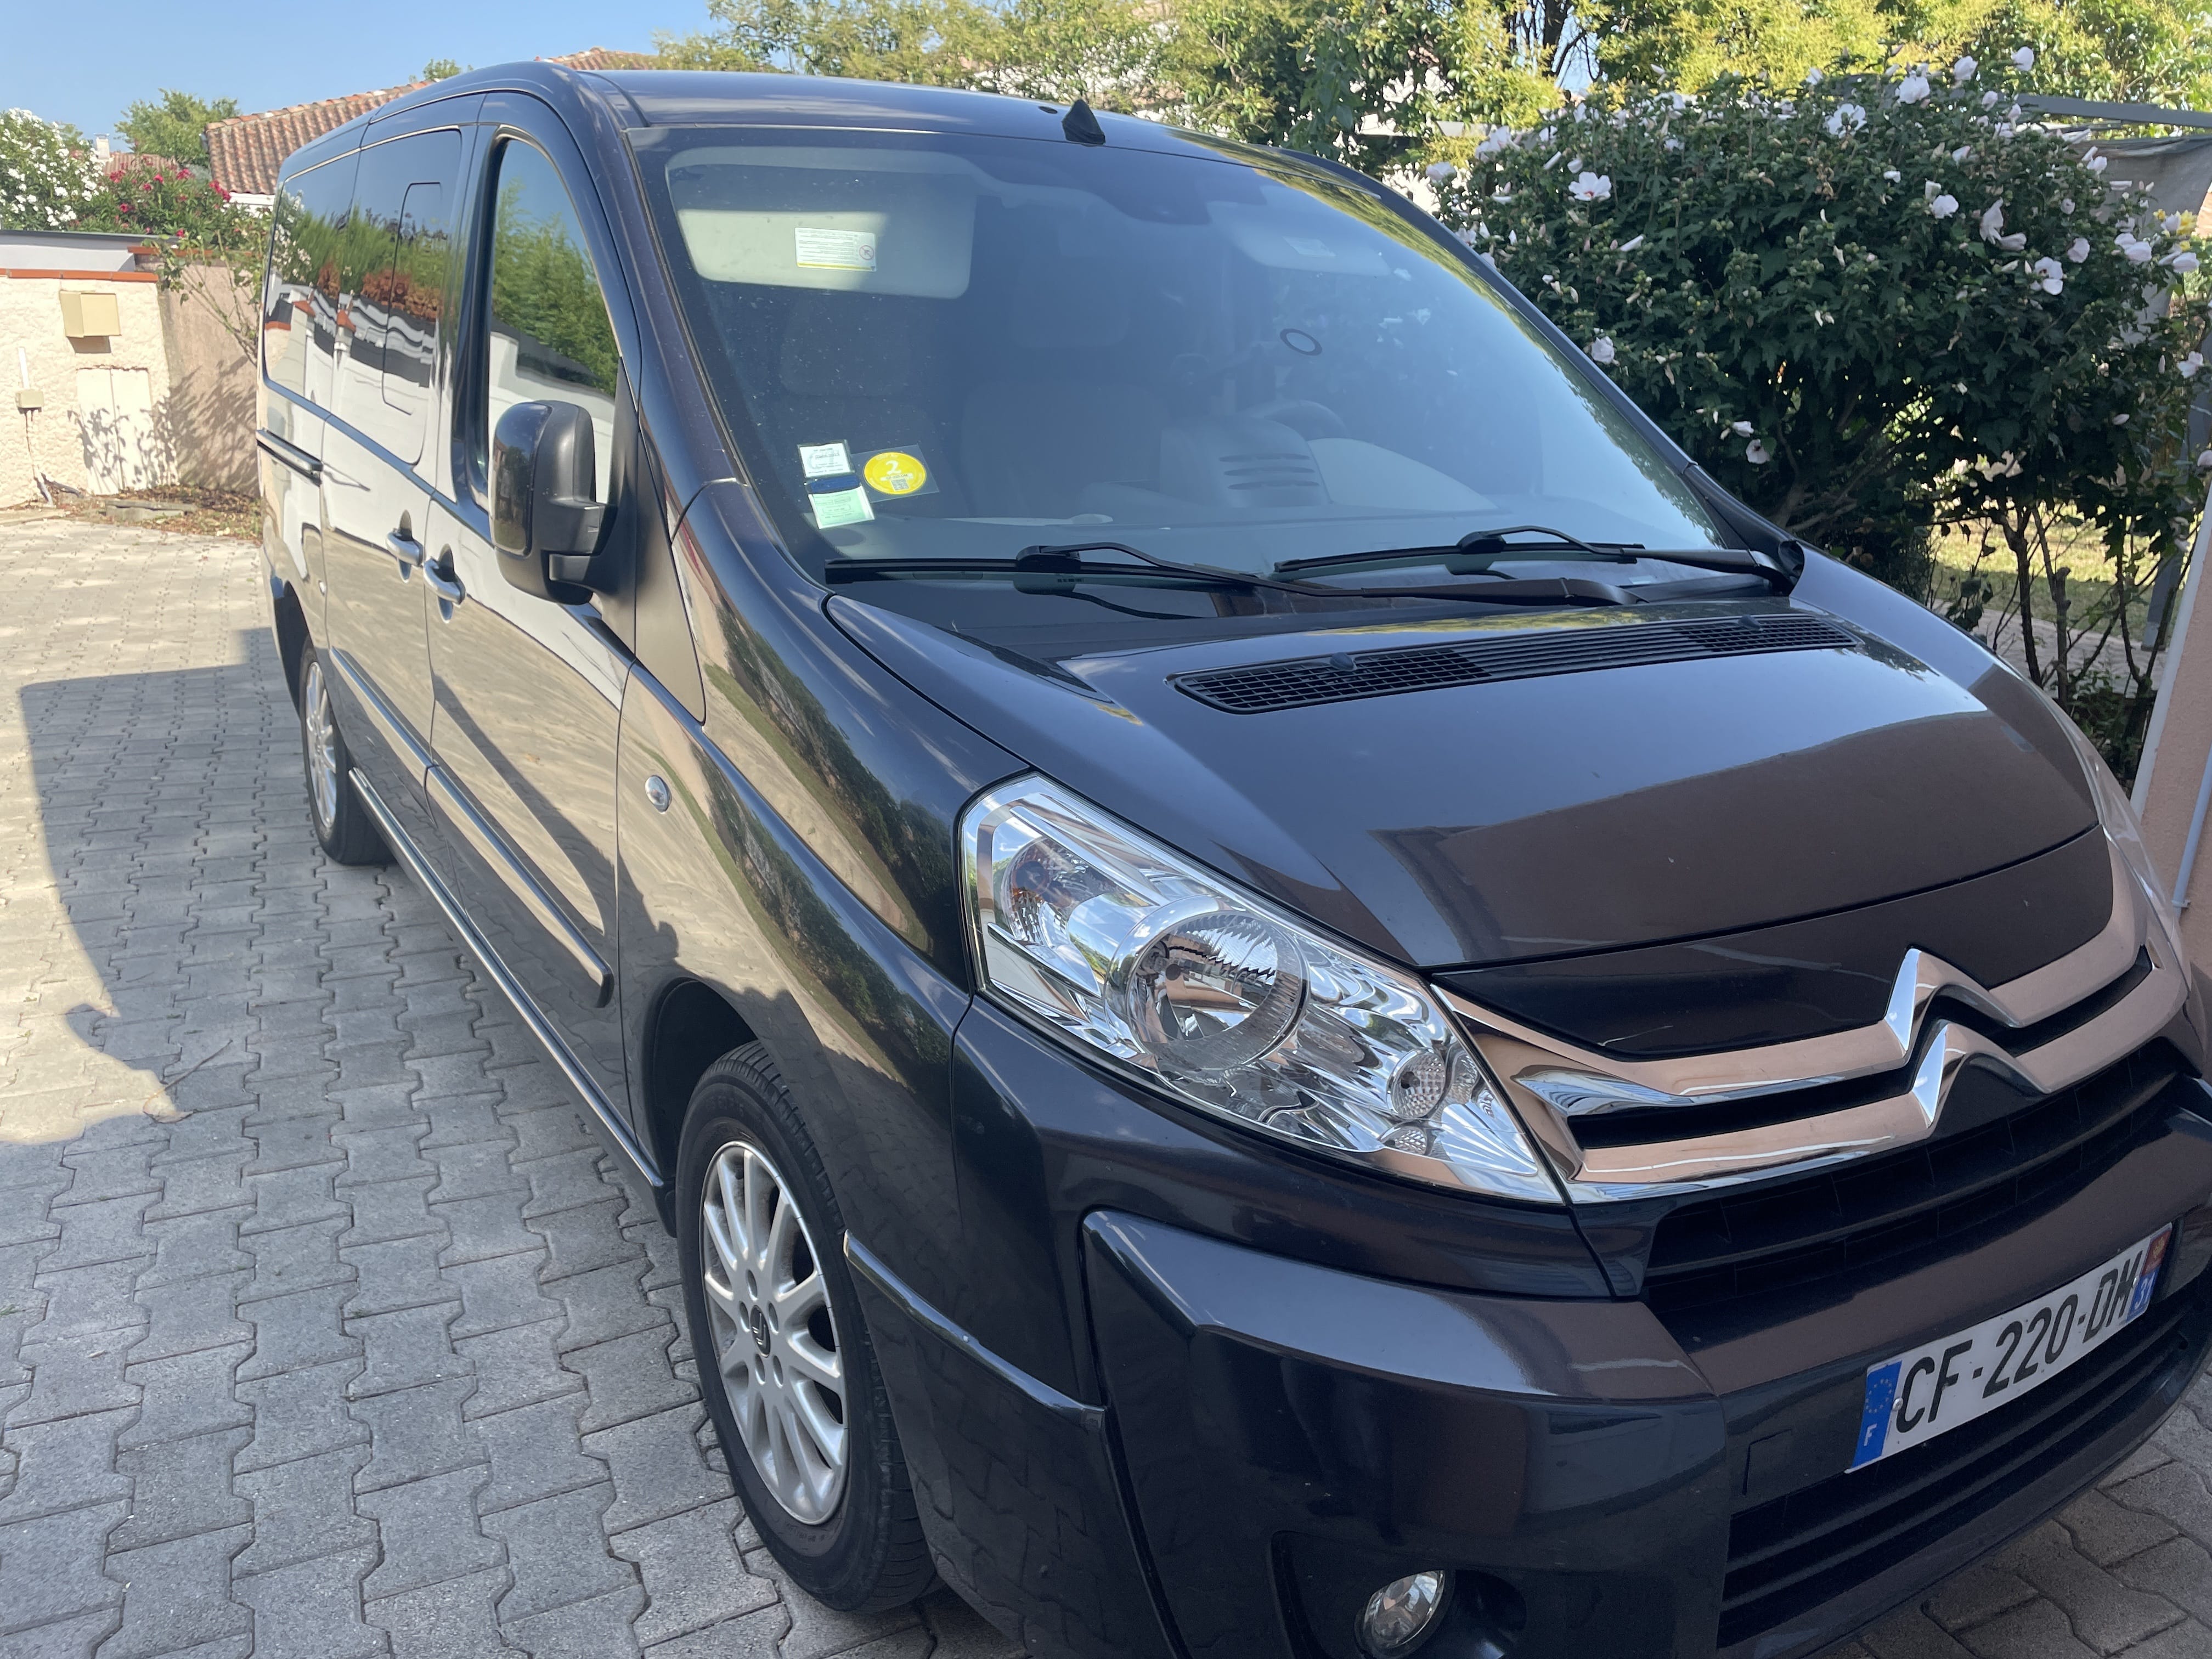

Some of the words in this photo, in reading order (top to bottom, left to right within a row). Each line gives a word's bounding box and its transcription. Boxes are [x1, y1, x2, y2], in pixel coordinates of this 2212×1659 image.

[885, 460, 902, 475] 2
[2134, 1272, 2155, 1310] 31
[1896, 1250, 2143, 1434] CF-220-DM
[1864, 1423, 1877, 1447] F
